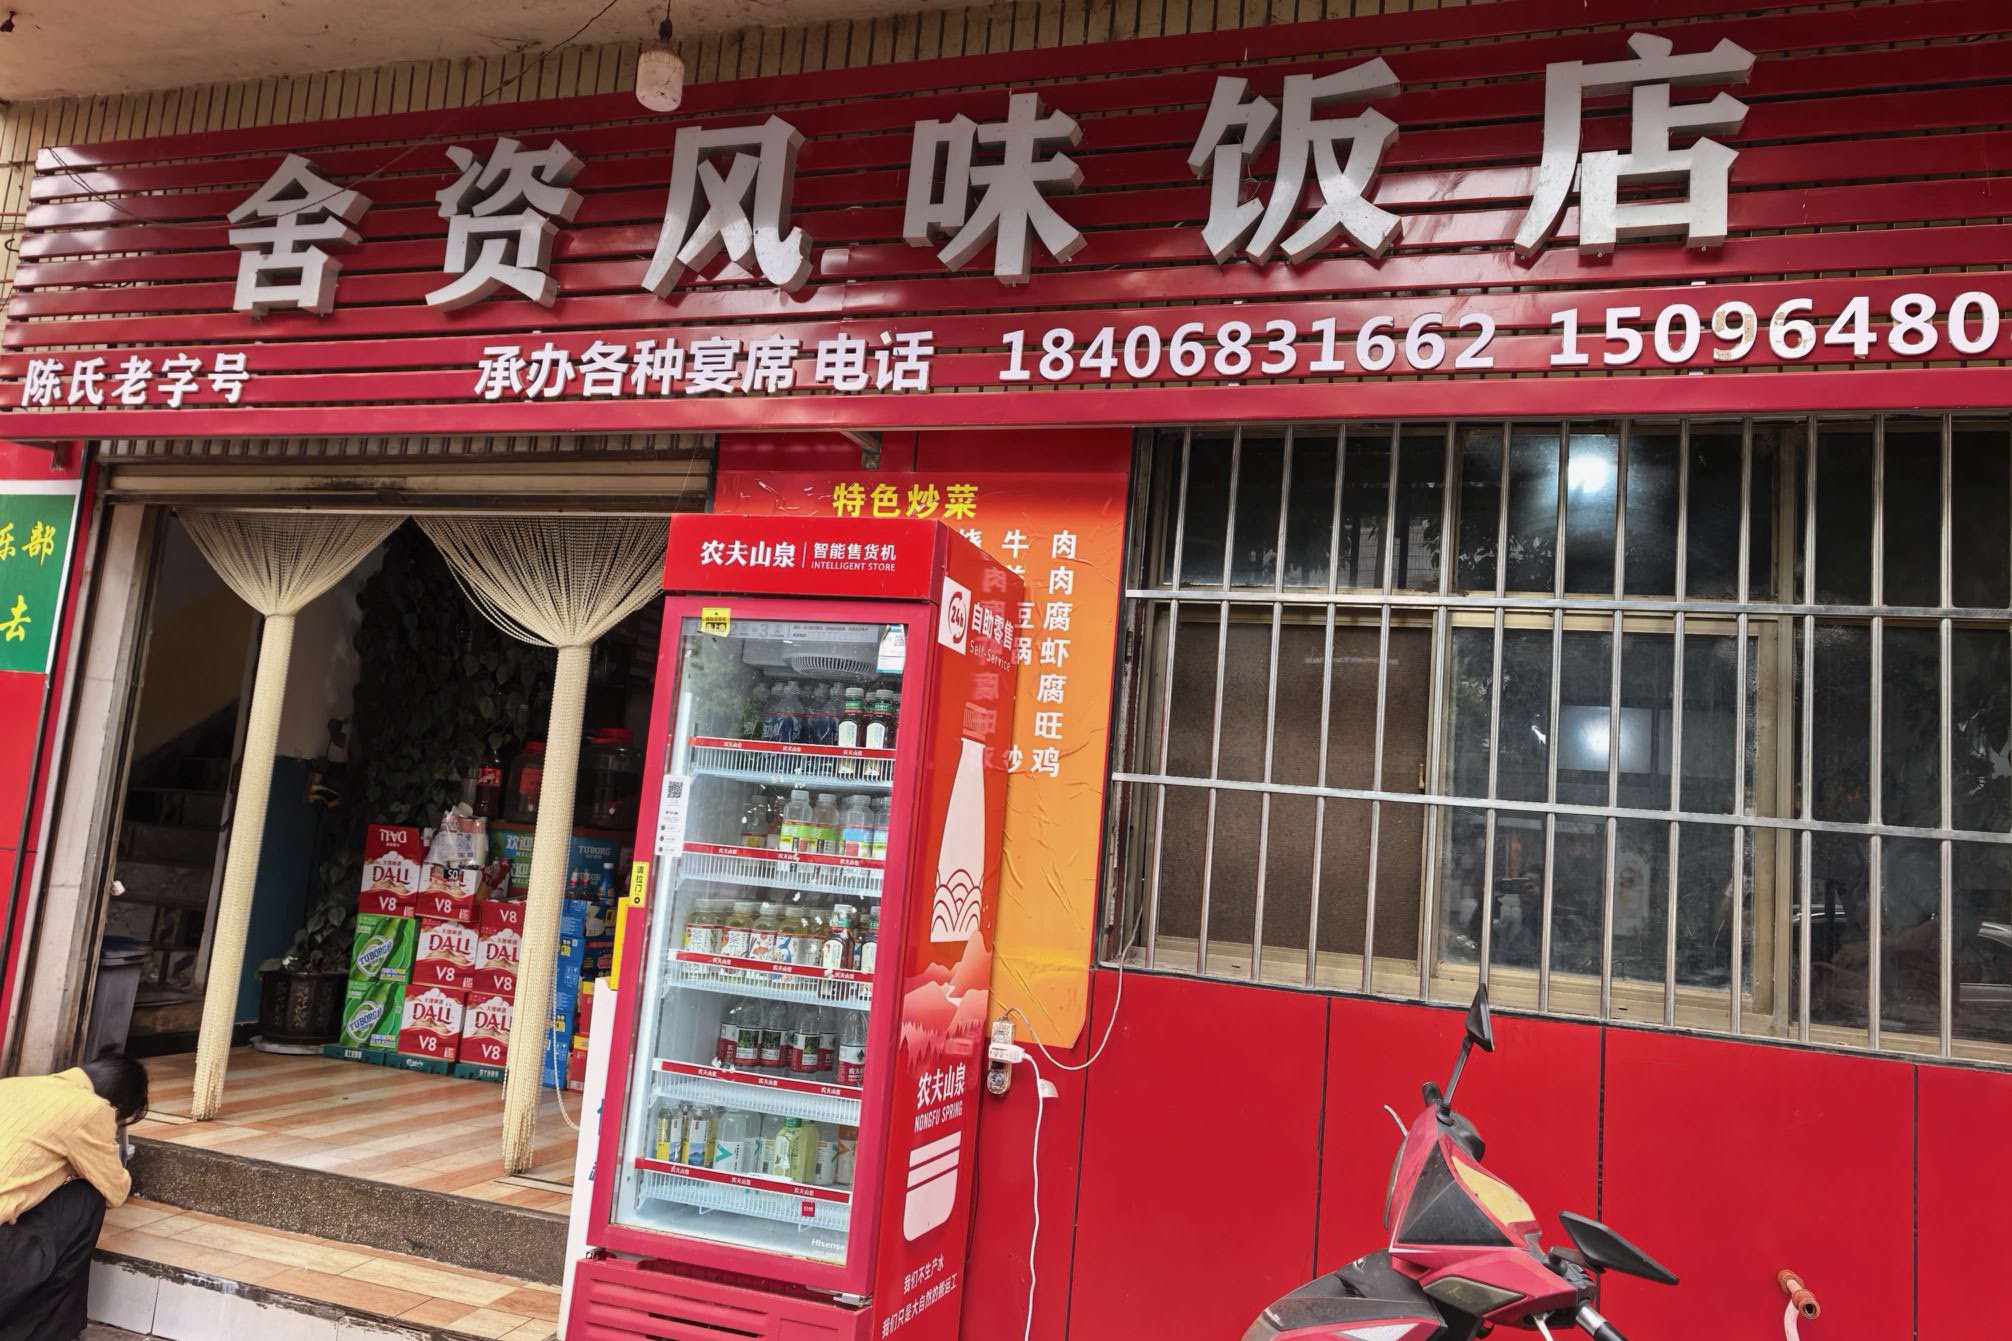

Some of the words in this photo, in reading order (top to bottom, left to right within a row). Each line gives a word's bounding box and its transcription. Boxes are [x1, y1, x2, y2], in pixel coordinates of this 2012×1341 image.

[226, 32, 1757, 314] 舍资风味饭店
[474, 334, 801, 398] 承办各种宴席
[815, 329, 935, 392] 电话
[999, 311, 1496, 381] 18406831662
[21, 352, 251, 408] 陈氏老字号
[832, 482, 979, 520] 特色炒菜
[701, 539, 796, 568] 农夫山泉
[813, 542, 896, 561] 智能售货机
[811, 561, 865, 571] INTELLIGENT
[867, 562, 896, 572] STORE
[0, 594, 31, 642] 去
[972, 602, 1014, 651] 自助零售
[969, 640, 1011, 672] Self-Service
[1036, 673, 1067, 704] 腐
[1034, 711, 1064, 740] 旺
[372, 866, 410, 885] DALI
[379, 896, 397, 911] V8
[435, 897, 452, 913] V8
[500, 909, 517, 923] V8
[359, 938, 393, 965] TUBORG
[429, 934, 471, 955] DALI
[486, 943, 520, 962] DAL
[436, 966, 455, 981] V8
[494, 975, 512, 990] V8
[349, 1004, 383, 1031] TUBORG
[412, 1003, 451, 1024] DALI
[419, 1035, 437, 1051] V8
[482, 1044, 500, 1060] V8
[917, 1062, 966, 1110] 农夫山泉
[914, 1108, 941, 1133] NONGFU
[941, 1099, 963, 1123] SPRING
[903, 1253, 944, 1295] 我们不生产水
[881, 1273, 958, 1339] 我们只是大自然的搬运工
